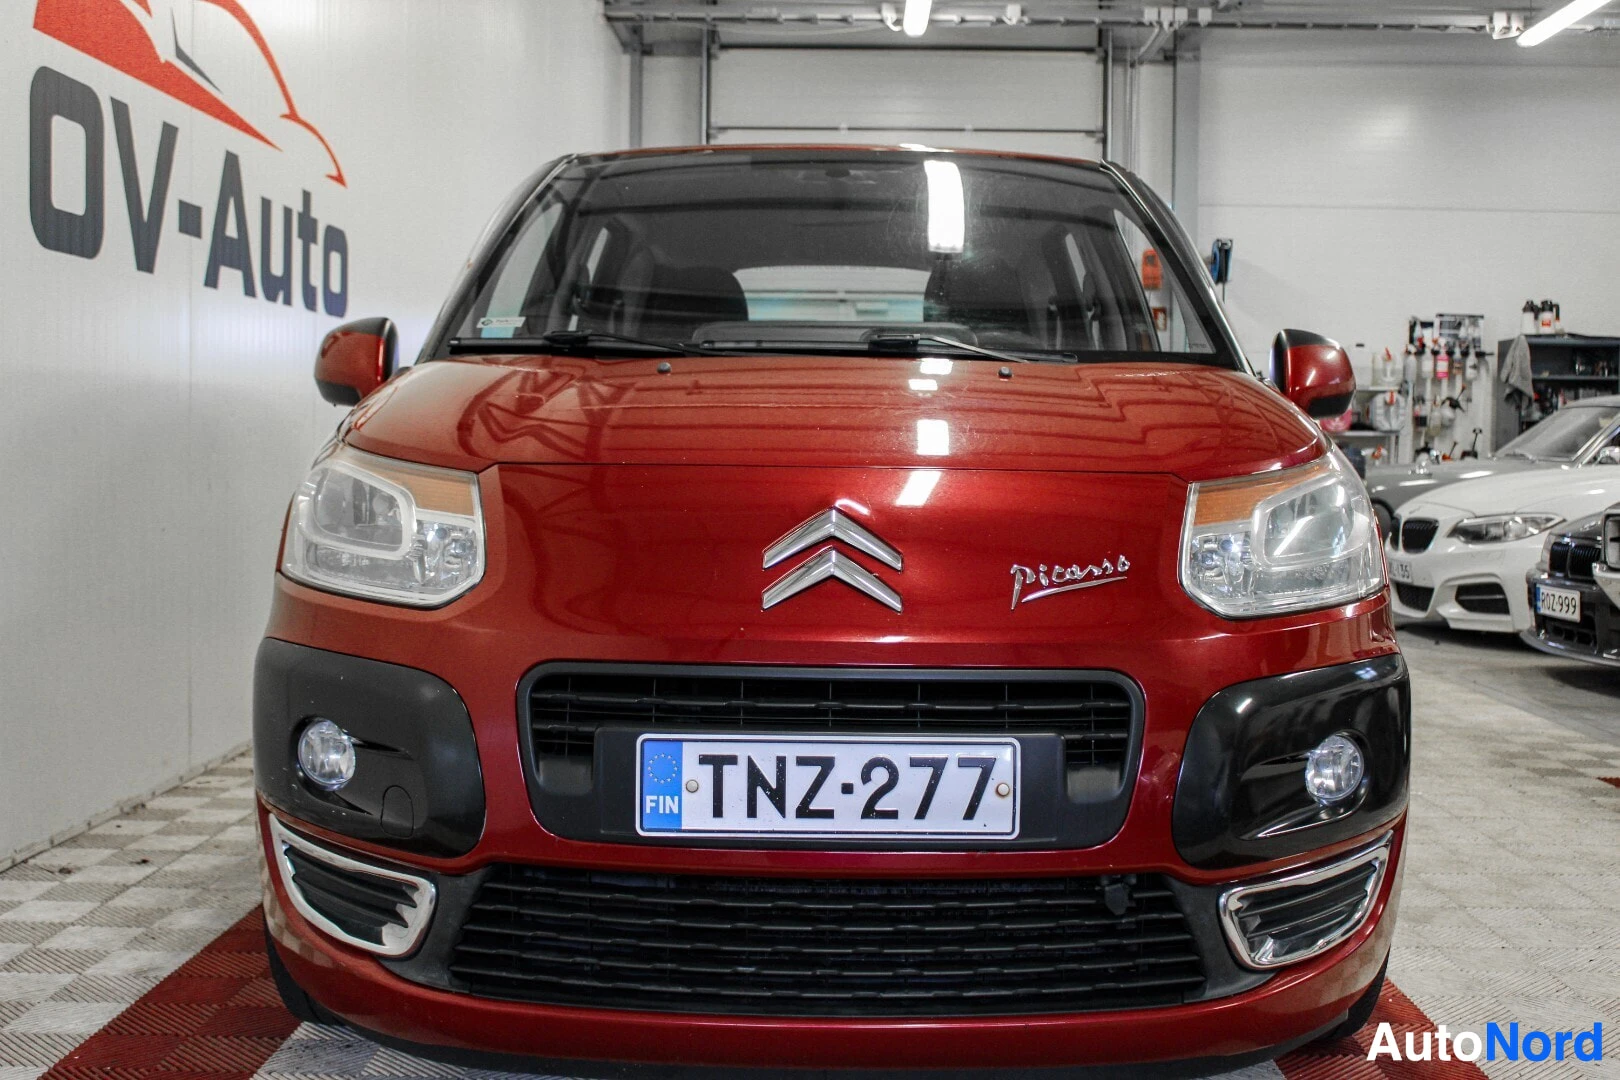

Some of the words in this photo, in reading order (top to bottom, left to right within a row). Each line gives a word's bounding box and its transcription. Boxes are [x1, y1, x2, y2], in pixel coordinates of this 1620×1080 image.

[29, 65, 349, 319] OV-Auto
[1541, 591, 1577, 615] ROZ-999
[645, 795, 679, 814] FIN
[698, 753, 997, 820] TNZ-277
